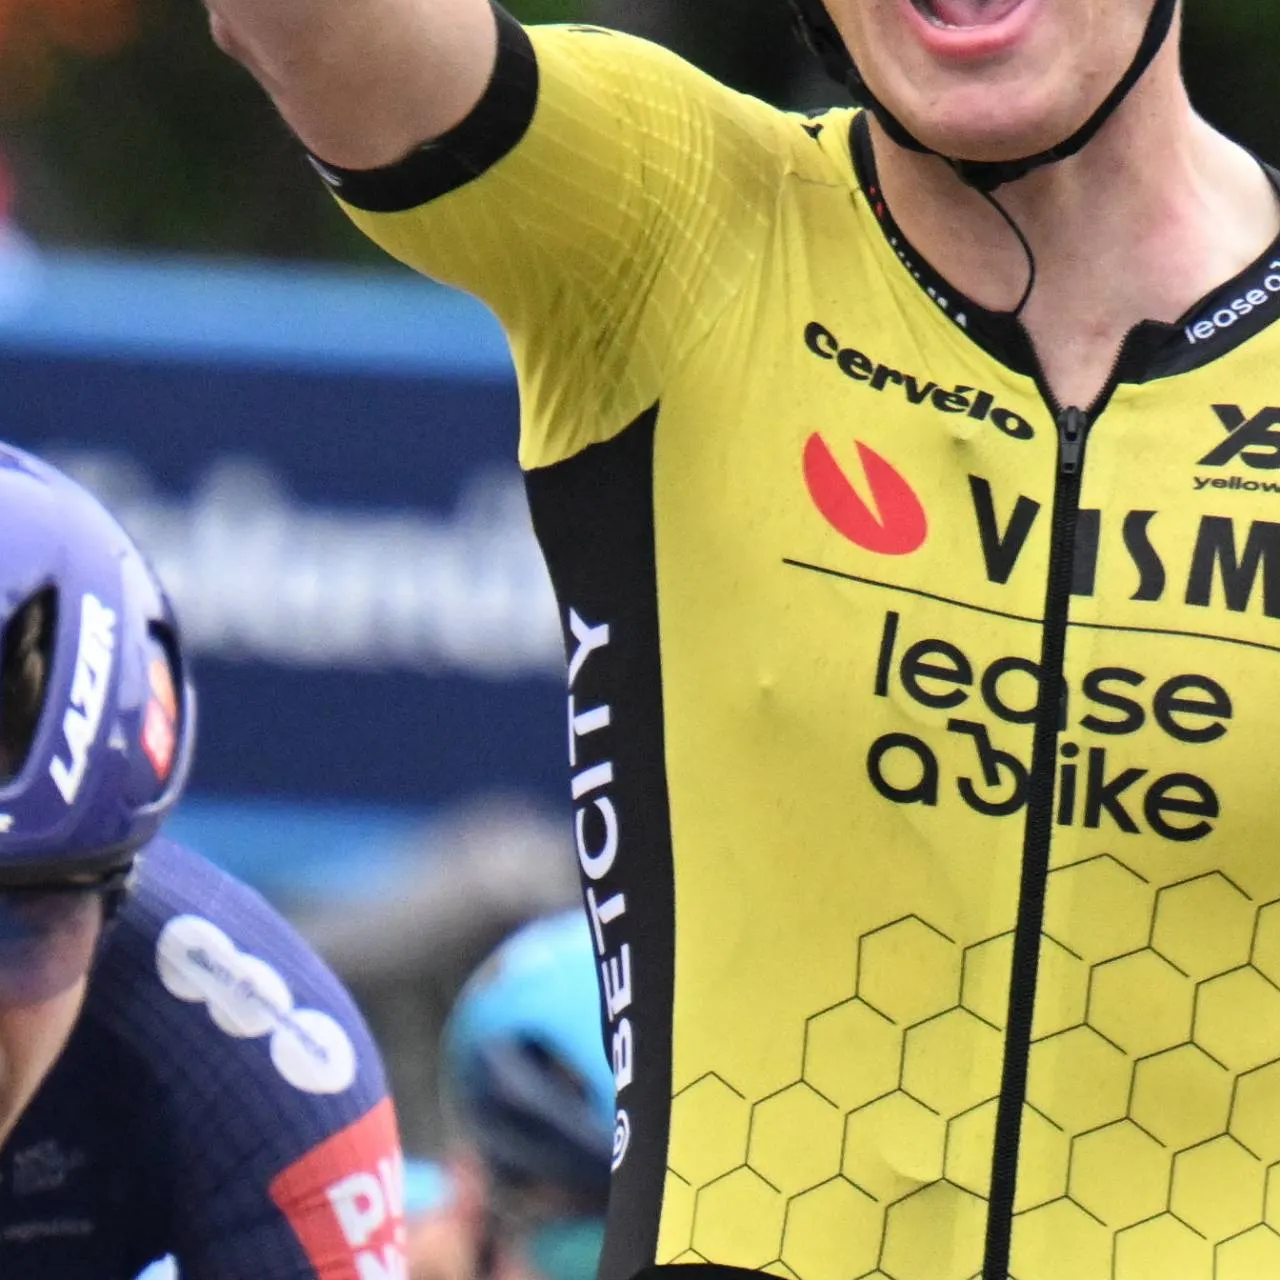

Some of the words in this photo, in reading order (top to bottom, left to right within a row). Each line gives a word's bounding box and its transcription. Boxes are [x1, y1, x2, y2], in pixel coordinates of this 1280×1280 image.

[804, 321, 1035, 440] cervélo
[49, 593, 116, 805] LAZER
[874, 610, 1233, 744] lease
